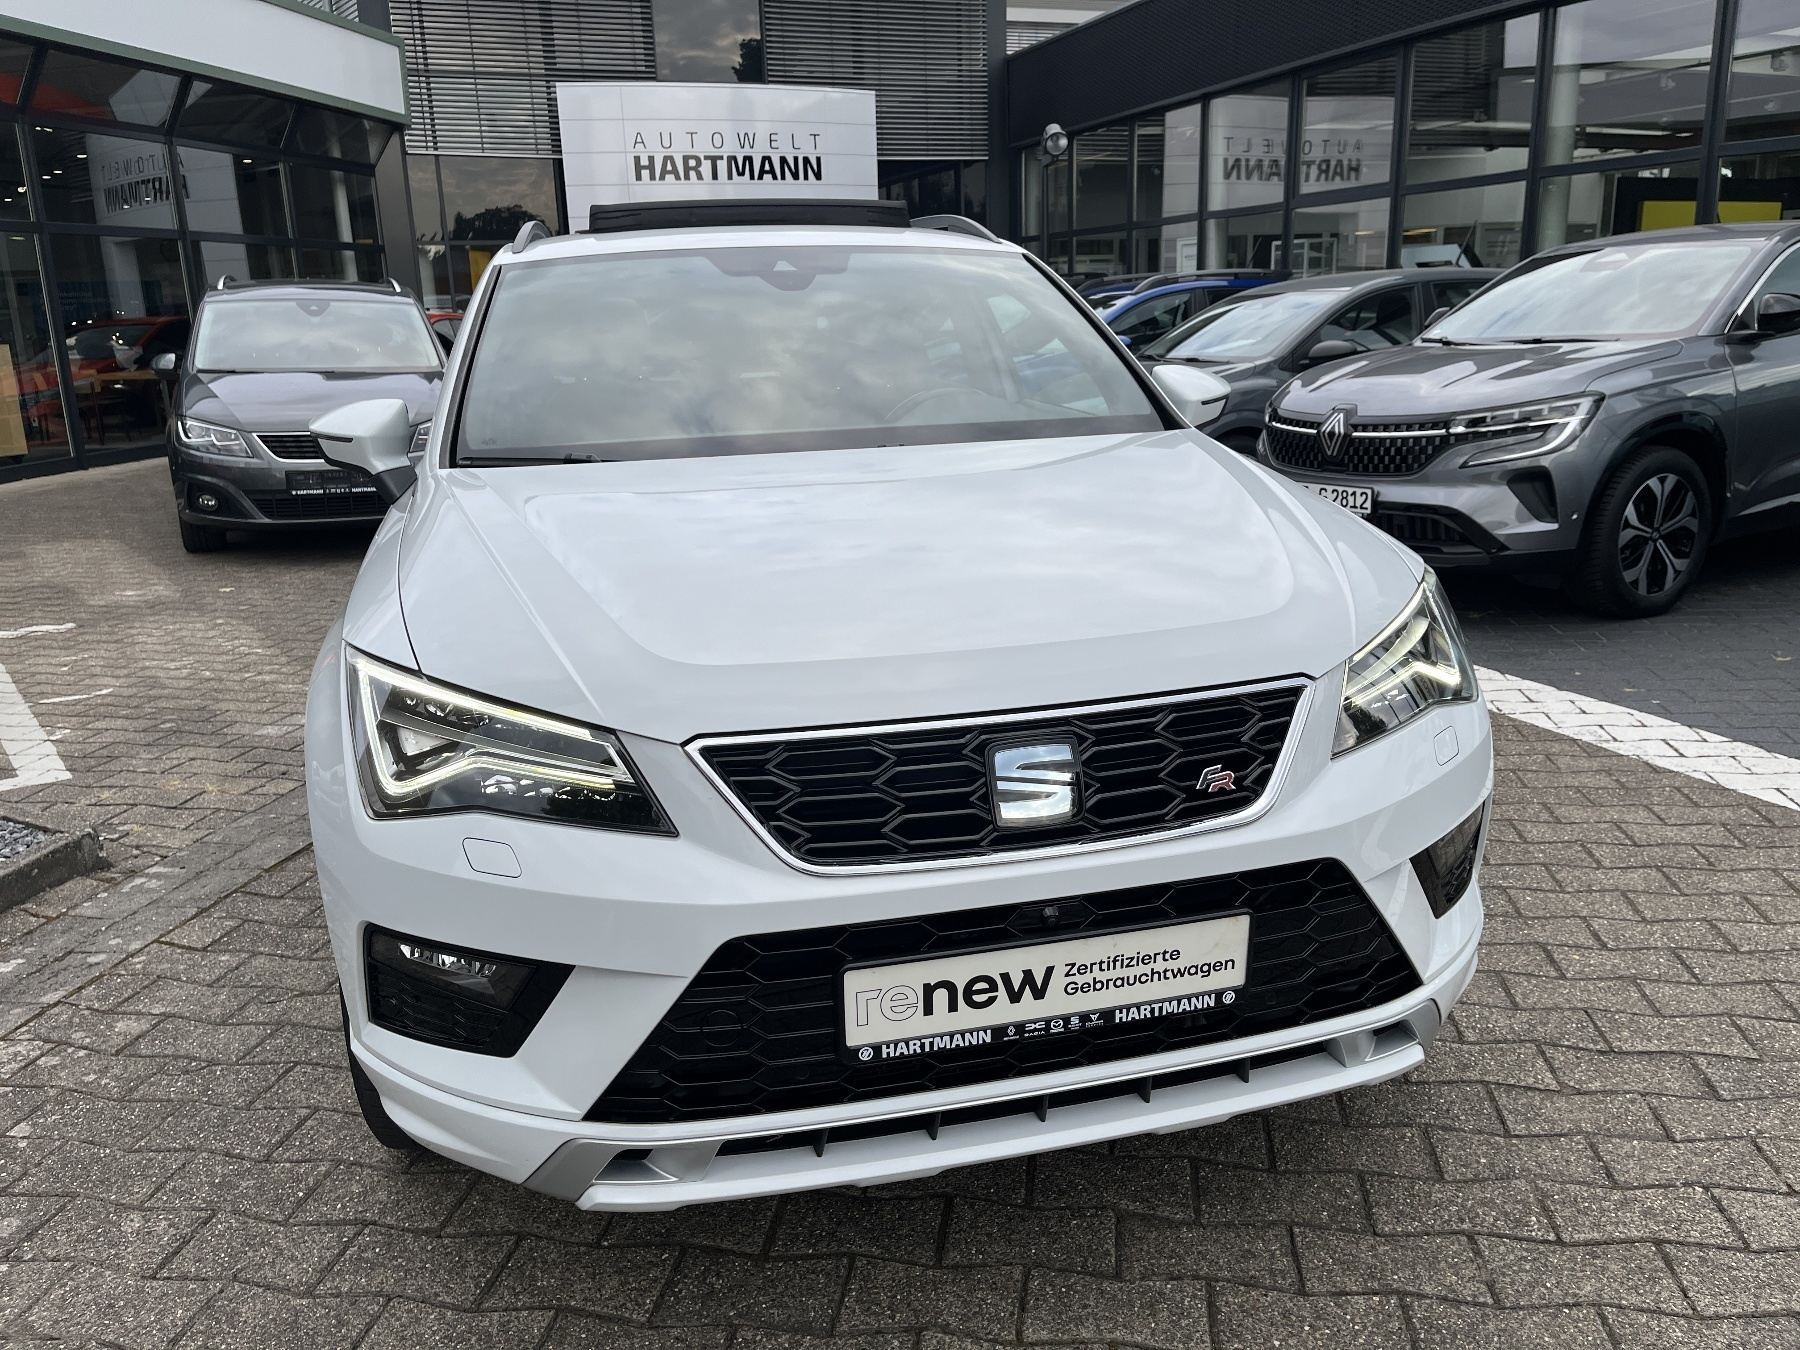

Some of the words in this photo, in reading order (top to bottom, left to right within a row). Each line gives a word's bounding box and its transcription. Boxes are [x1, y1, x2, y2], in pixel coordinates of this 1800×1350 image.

[633, 132, 820, 150] AUTOWELT
[633, 154, 823, 182] HARTMANN
[1331, 488, 1369, 511] 2812
[1196, 764, 1236, 792] FR
[1064, 949, 1181, 978] Zertifizierte
[1064, 958, 1236, 996] Gebrauchtwagen
[856, 965, 1055, 1027] renew
[881, 1029, 992, 1058] HARTMANN
[1115, 993, 1216, 1023] HARTMANN
